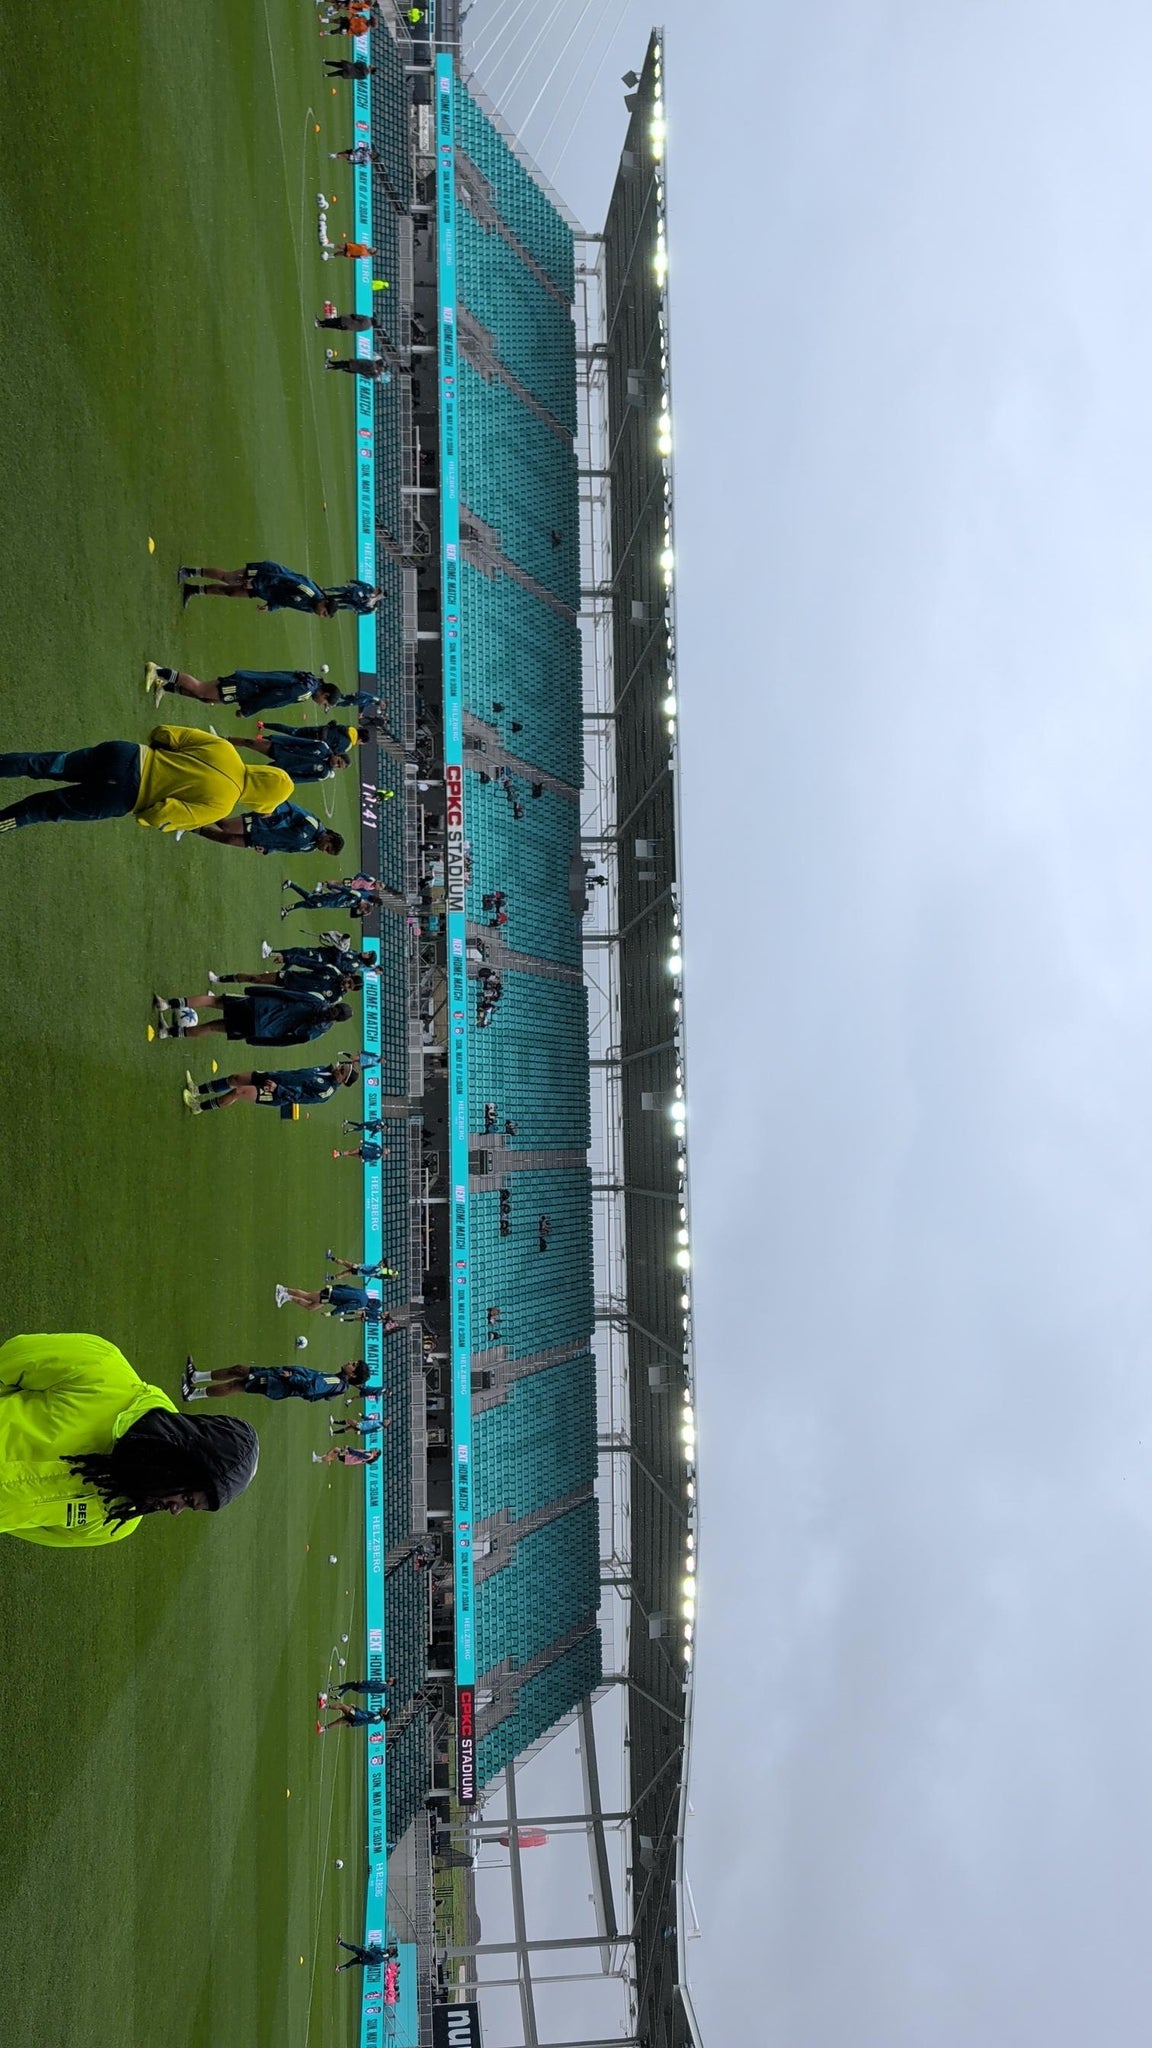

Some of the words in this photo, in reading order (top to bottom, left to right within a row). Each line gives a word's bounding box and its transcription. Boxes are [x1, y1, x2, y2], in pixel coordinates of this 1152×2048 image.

[357, 80, 368, 109] MATCH
[442, 114, 450, 136] MATCH
[359, 336, 370, 359] NEXT
[444, 344, 453, 367] MATCH
[360, 386, 371, 416] MATCH
[364, 542, 372, 582] HELZBE
[447, 561, 456, 581] HOME
[448, 582, 456, 605] MATCH
[446, 766, 462, 826] CPKC
[448, 831, 463, 911] STADIUM
[453, 957, 463, 977] HOME
[366, 983, 378, 1009] HOME
[454, 978, 463, 1000] MATCH
[367, 1011, 378, 1042] MATCH
[456, 1204, 465, 1224] HOME
[456, 1225, 465, 1249] MATCH
[368, 1322, 378, 1341] OME
[368, 1344, 379, 1376] MATCH
[458, 1444, 468, 1462] NEXT
[459, 1464, 468, 1485] HOME
[370, 1480, 378, 1507] 11:30AM
[459, 1487, 468, 1511] MATCH
[372, 1515, 381, 1573] HELZBERG
[370, 1629, 382, 1652] NEXT
[370, 1694, 382, 1711] ATC
[461, 1692, 472, 1736] CPKC
[462, 1739, 472, 1798] STADIUM
[373, 1792, 382, 1806] MAY
[373, 1826, 382, 1854] 11:30AM
[374, 1862, 384, 1897] HELZBERG
[367, 2032, 377, 2043] MAY
[448, 2010, 471, 2048] nu
